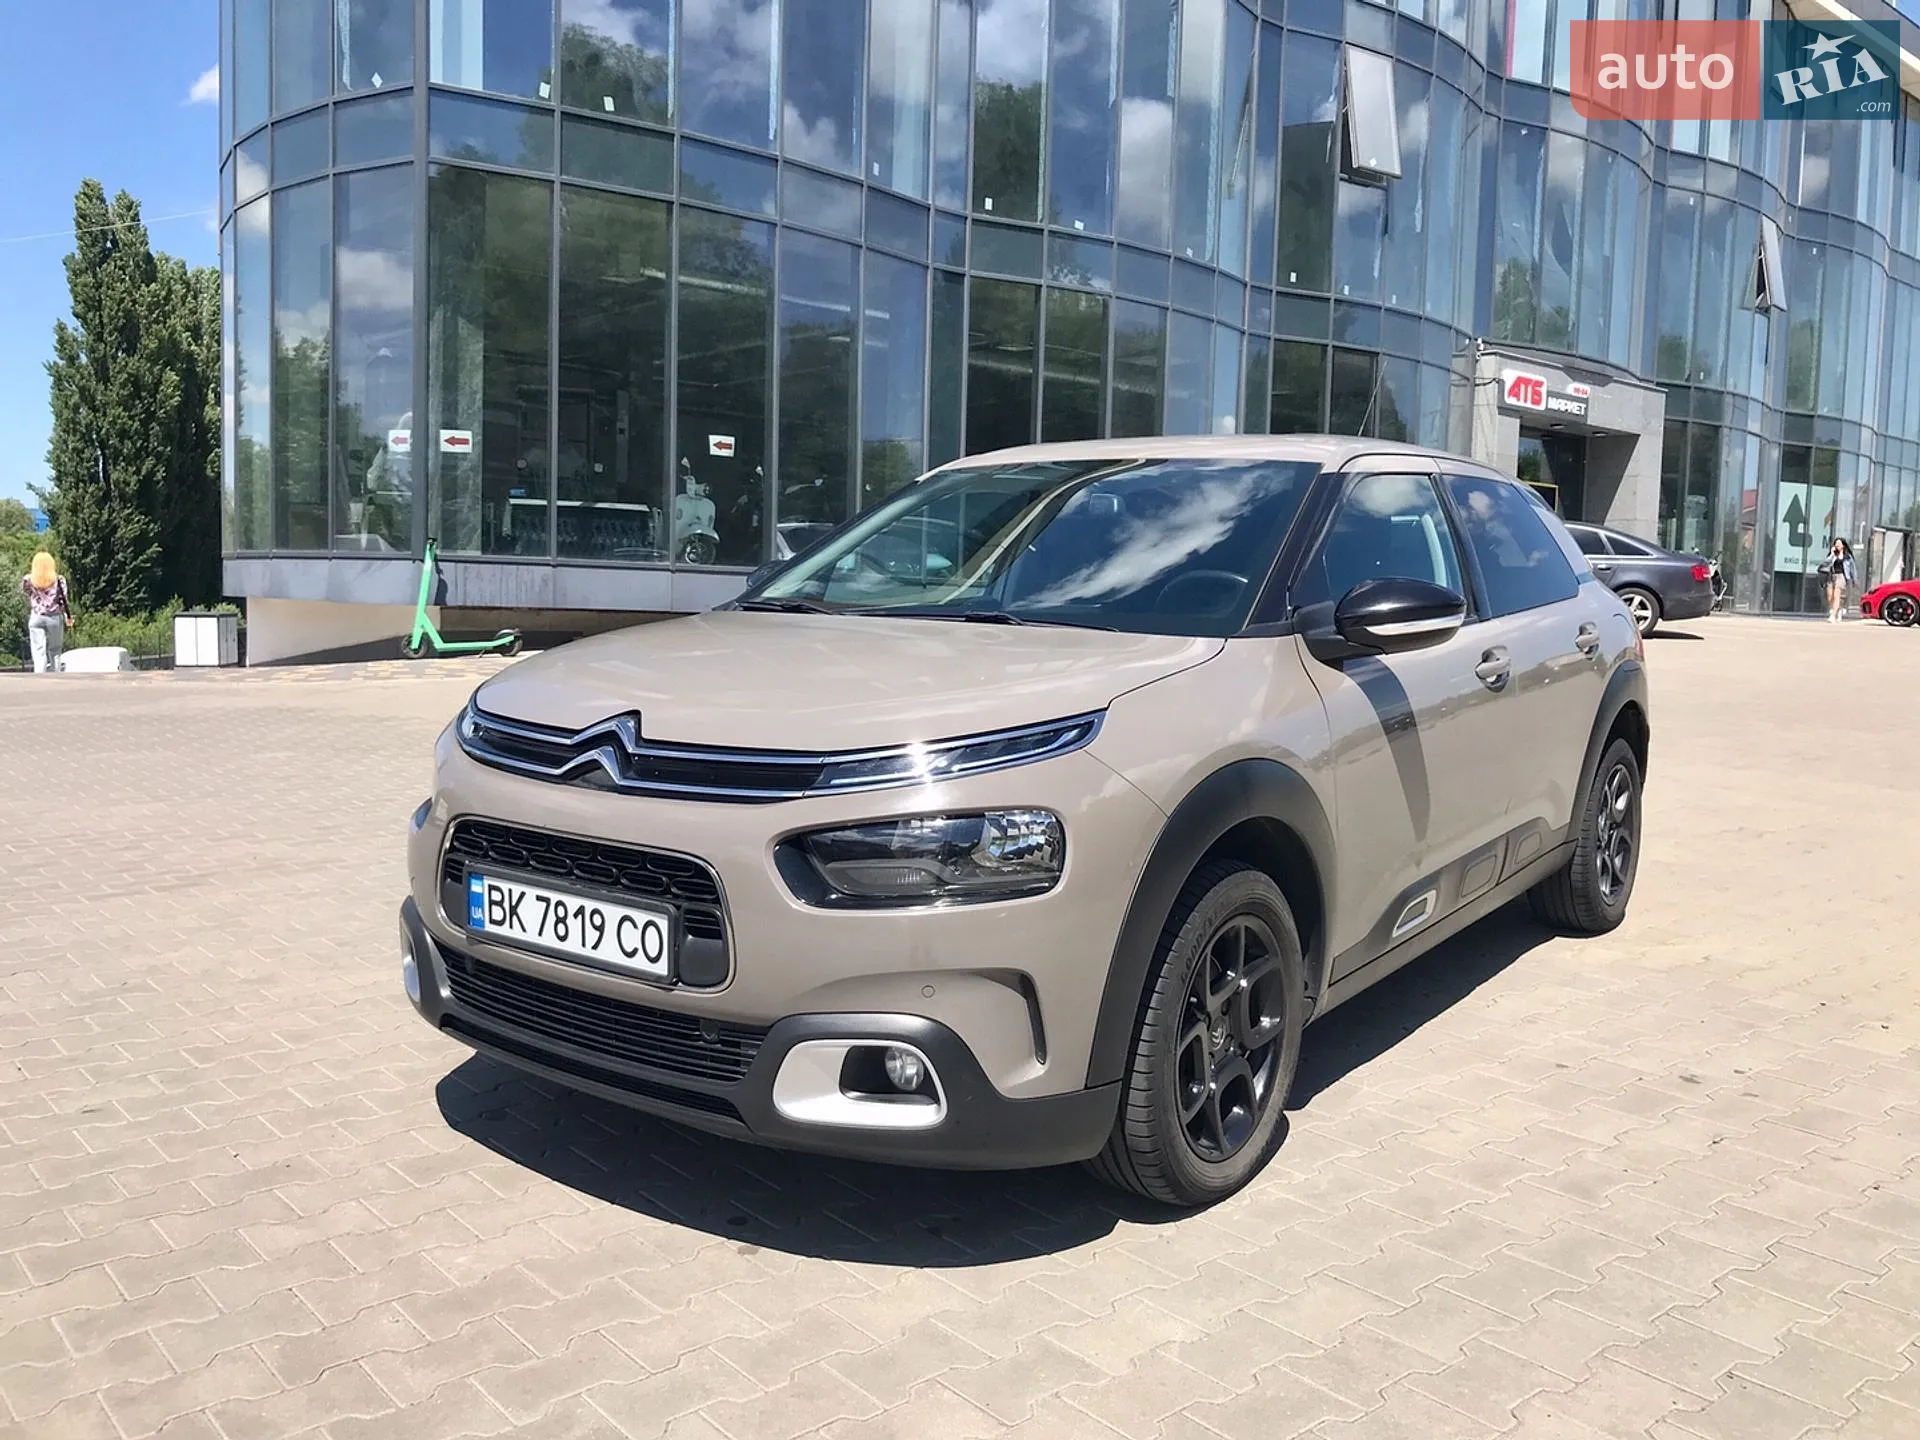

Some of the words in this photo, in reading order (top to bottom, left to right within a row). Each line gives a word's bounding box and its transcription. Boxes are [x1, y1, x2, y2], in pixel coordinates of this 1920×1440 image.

[1507, 376, 1545, 406] АТБ
[1548, 396, 1587, 415] МАРКЕТ
[471, 907, 483, 920] UA
[487, 884, 526, 933] BK
[535, 895, 606, 951] 7819
[616, 914, 664, 964] CO
